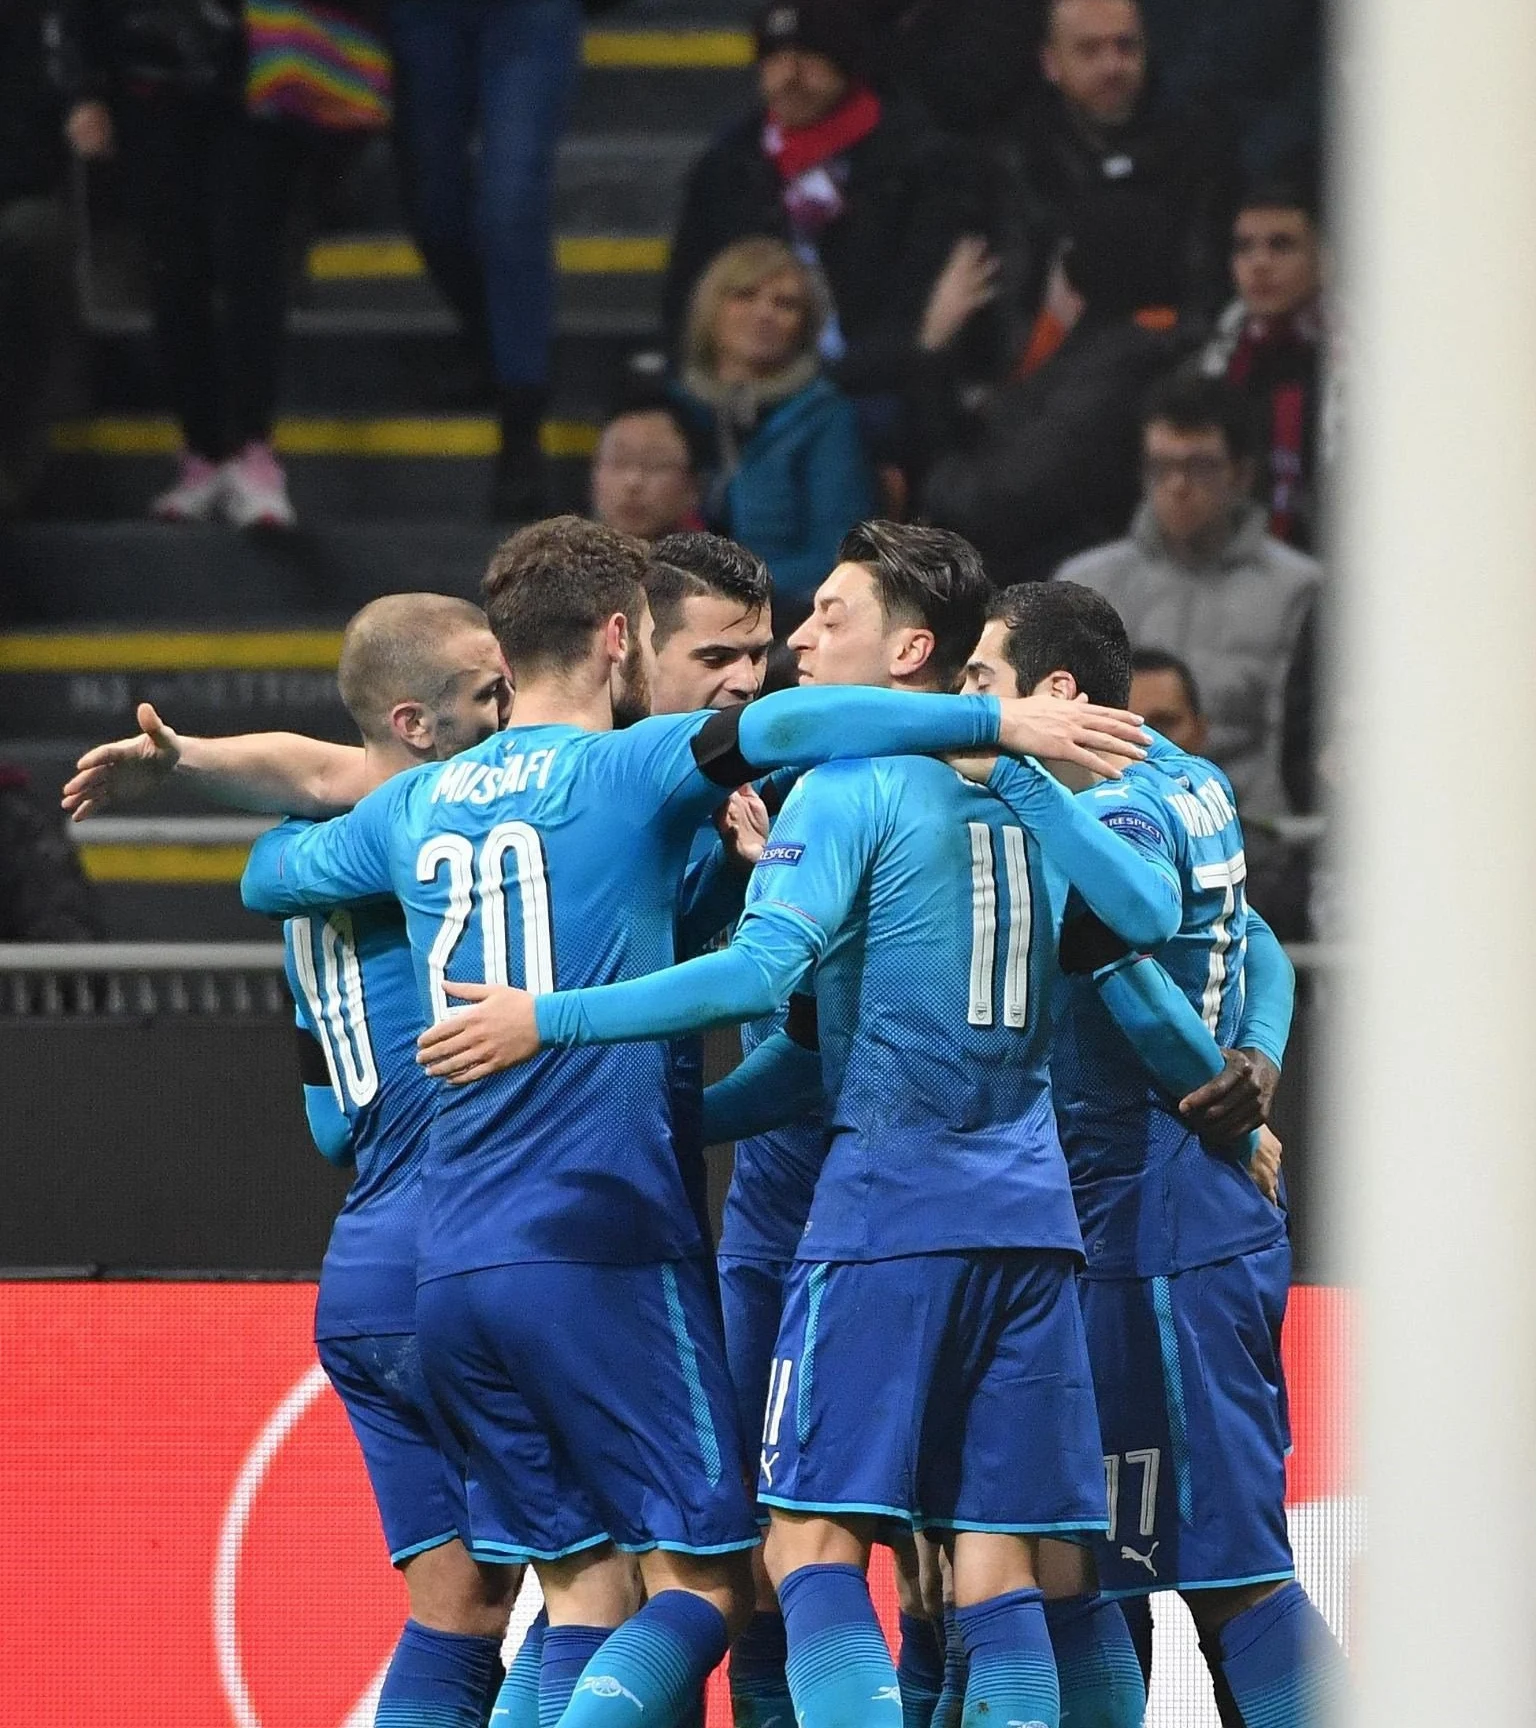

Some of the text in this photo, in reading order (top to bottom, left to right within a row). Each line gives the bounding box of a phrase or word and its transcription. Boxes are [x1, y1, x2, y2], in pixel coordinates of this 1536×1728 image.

[416, 820, 555, 1024] 20
[968, 822, 1032, 1029] 11
[1109, 815, 1162, 839] RESPECT
[292, 908, 379, 1113] 10
